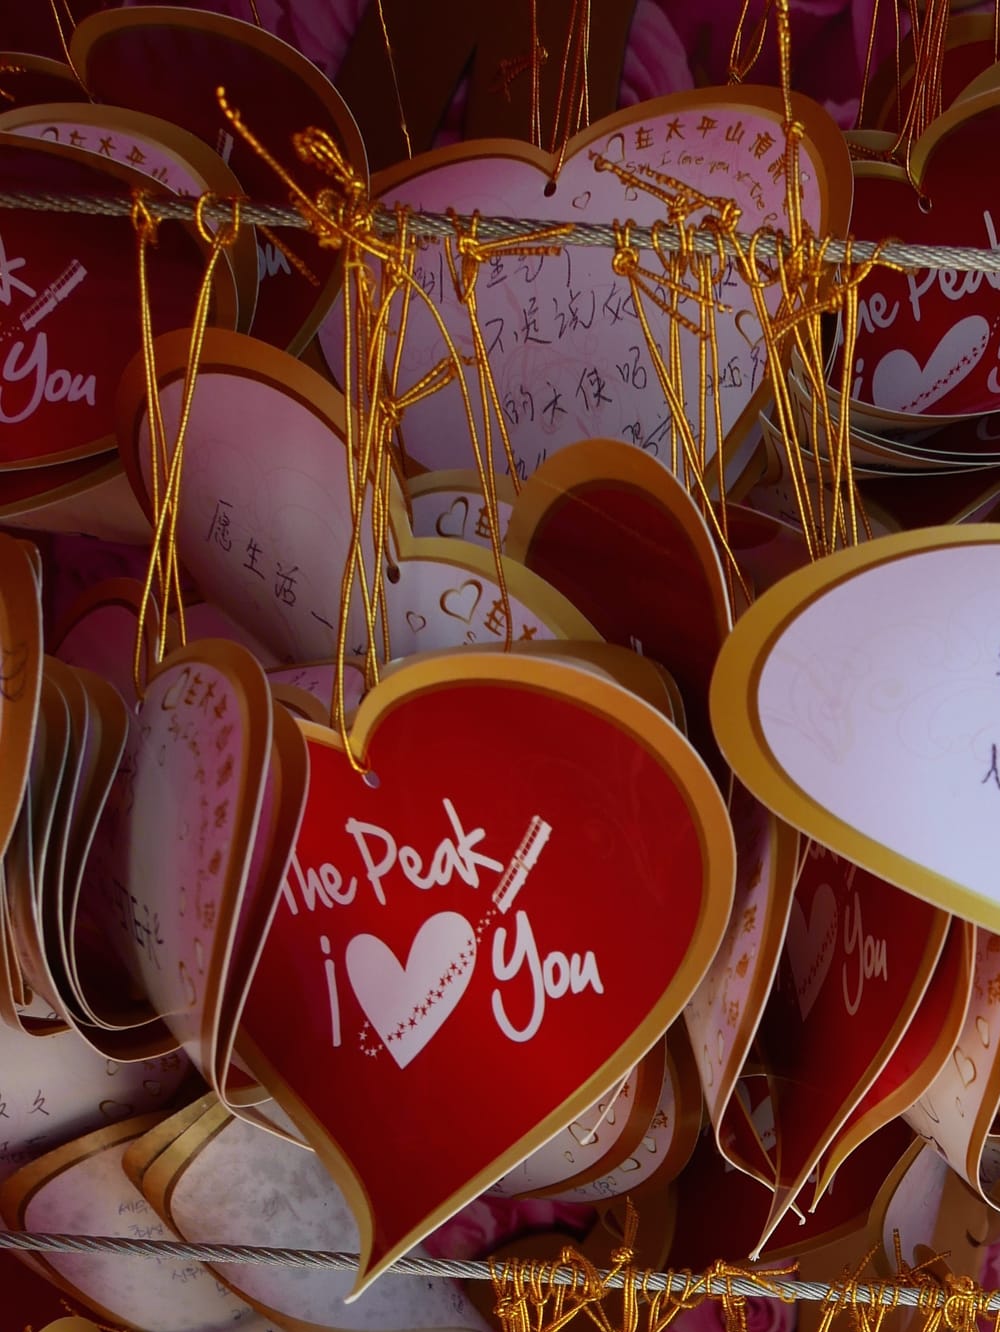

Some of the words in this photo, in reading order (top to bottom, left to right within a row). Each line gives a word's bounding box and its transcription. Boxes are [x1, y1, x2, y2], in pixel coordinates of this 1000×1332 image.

[0, 331, 96, 423] You
[345, 797, 504, 906] Peak
[320, 934, 342, 1047] i
[491, 910, 605, 1042] You
[843, 892, 887, 1016] You
